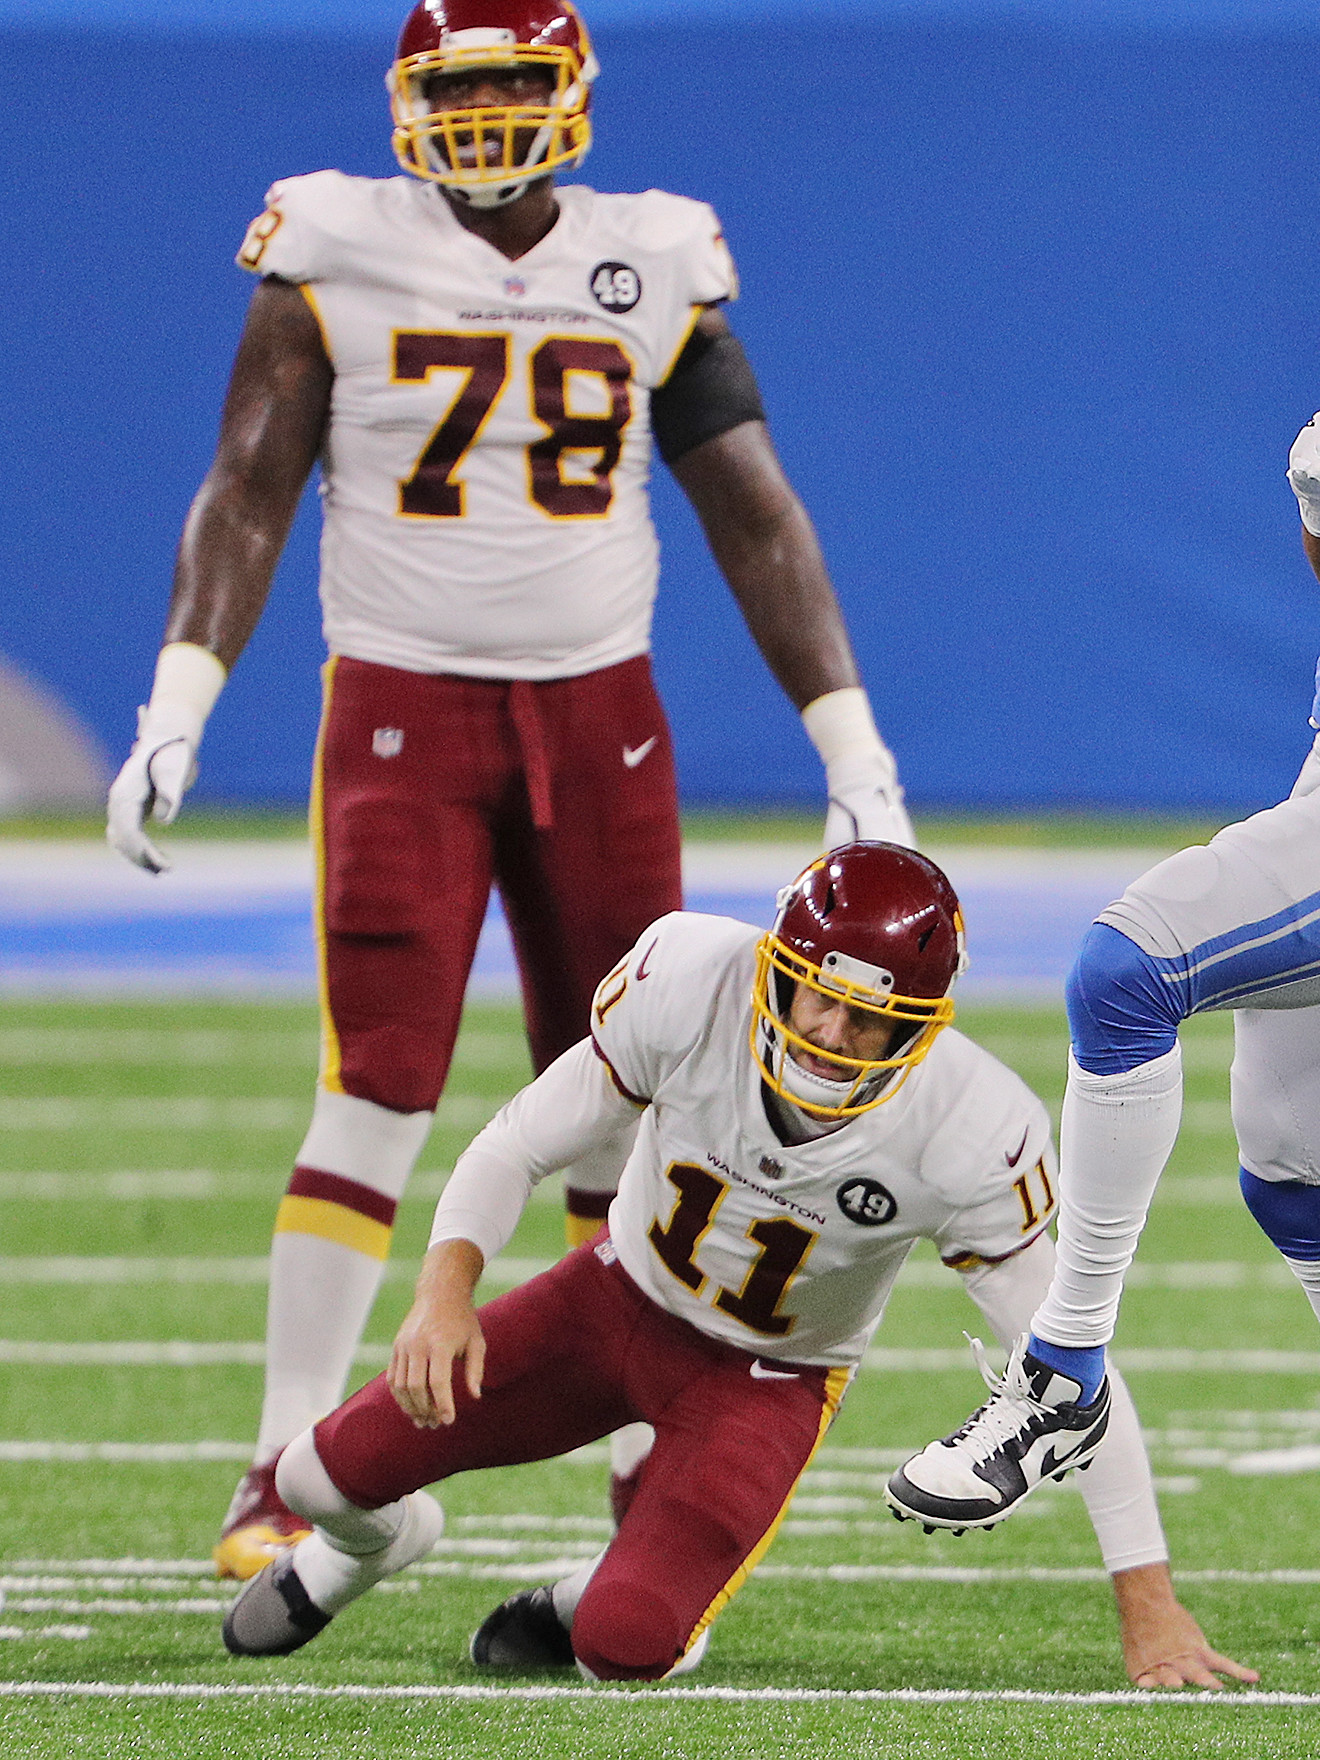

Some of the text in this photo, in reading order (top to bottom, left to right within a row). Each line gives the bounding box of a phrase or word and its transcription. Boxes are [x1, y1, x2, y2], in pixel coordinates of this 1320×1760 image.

[459, 310, 591, 324] WASHINGTON
[593, 268, 639, 305] 49
[389, 327, 636, 521] 78
[706, 1151, 827, 1225] WASHINGTON
[842, 1184, 890, 1219] 49
[1012, 1153, 1055, 1234] 11
[647, 1160, 821, 1337] 11
